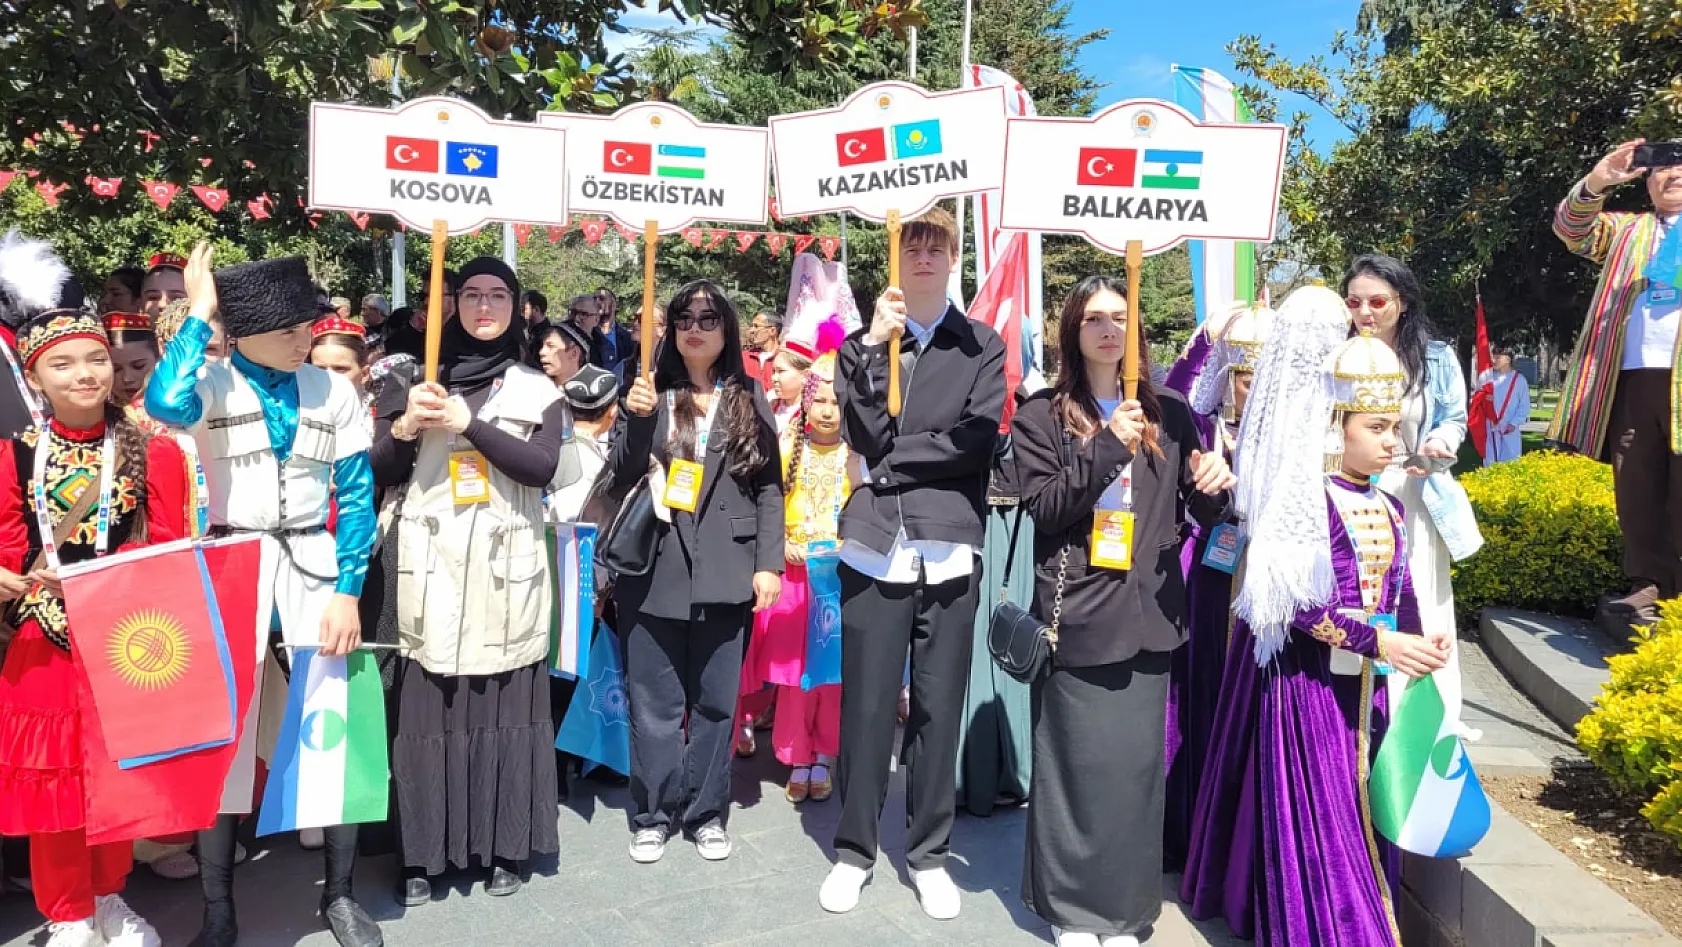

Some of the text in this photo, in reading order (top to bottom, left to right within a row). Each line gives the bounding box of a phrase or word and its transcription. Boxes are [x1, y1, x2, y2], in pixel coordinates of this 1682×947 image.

[390, 178, 493, 206] KOSOVA
[581, 175, 724, 207] ÖZBEKİSTAN
[818, 159, 968, 198] KAZAKİSTAN
[1063, 194, 1208, 222] BALKARYA
